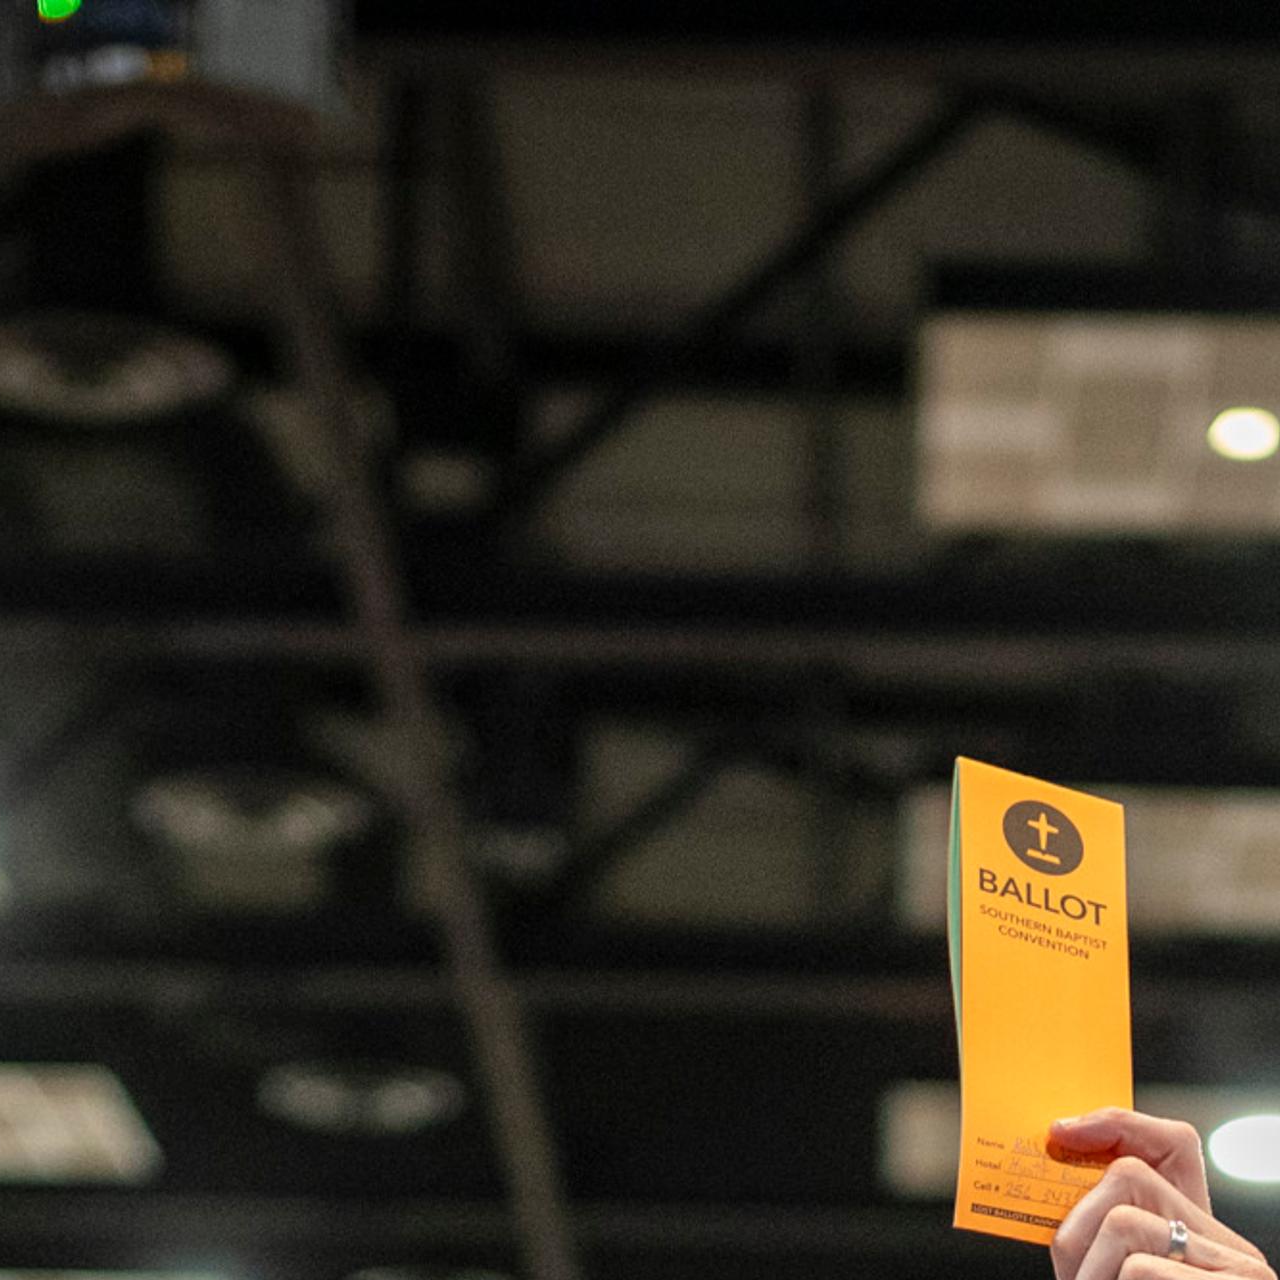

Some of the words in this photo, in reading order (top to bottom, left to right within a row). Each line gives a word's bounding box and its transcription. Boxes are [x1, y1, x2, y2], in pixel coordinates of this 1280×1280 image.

[979, 868, 1107, 926] BALLOT
[979, 904, 1051, 934] SOUTHERN
[1055, 927, 1107, 950] BAPTIST
[998, 925, 1089, 959] CONVENTION
